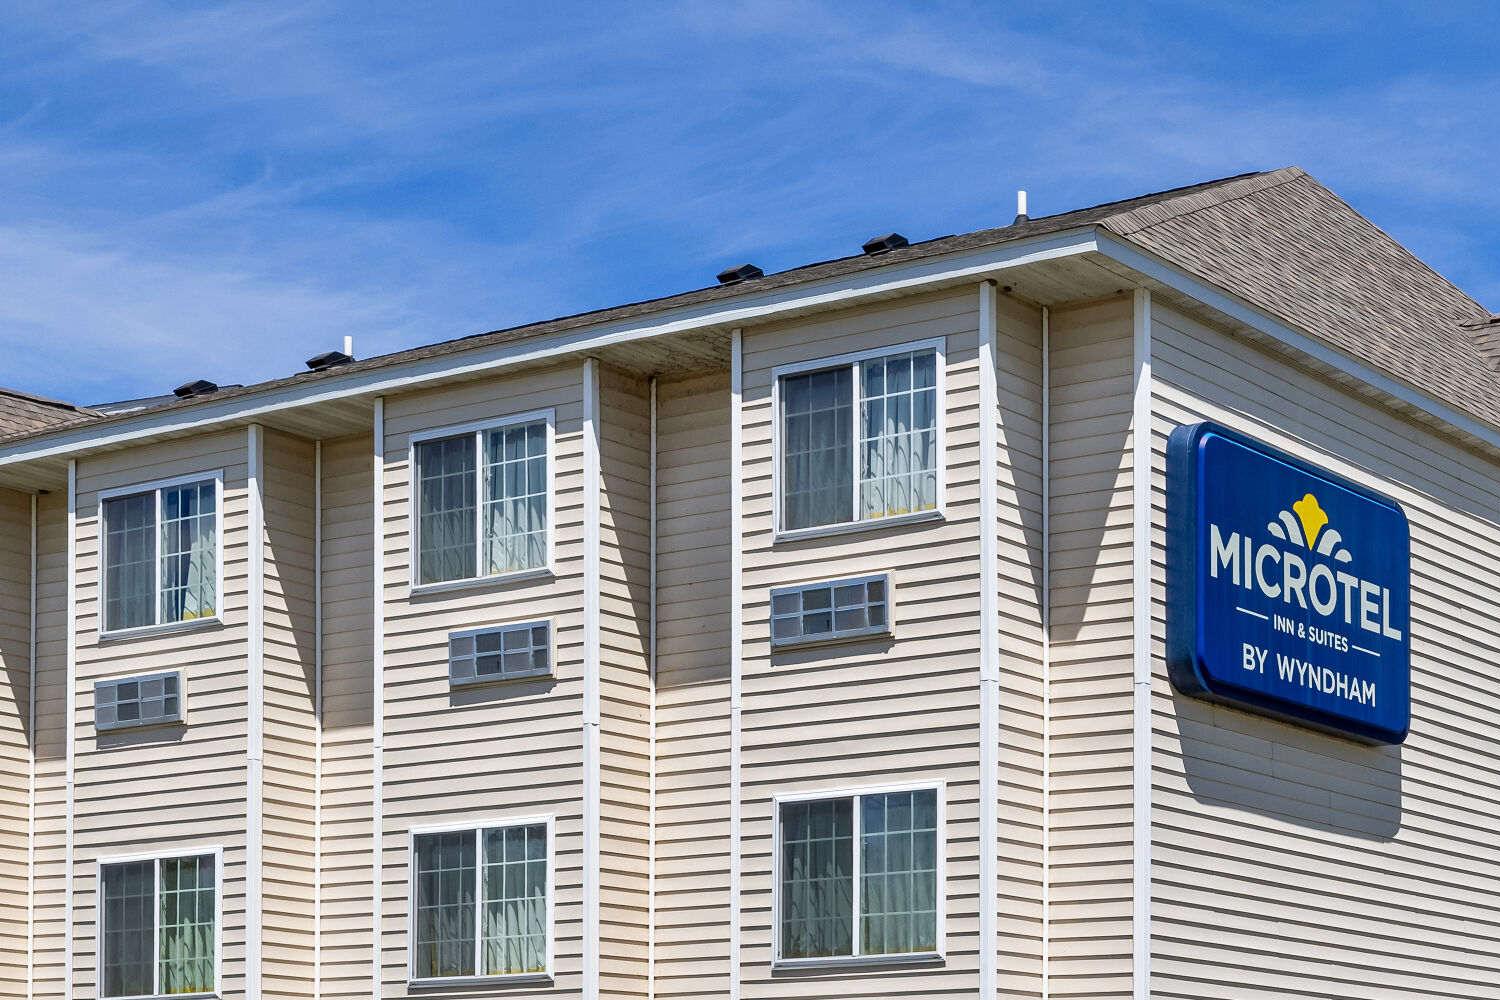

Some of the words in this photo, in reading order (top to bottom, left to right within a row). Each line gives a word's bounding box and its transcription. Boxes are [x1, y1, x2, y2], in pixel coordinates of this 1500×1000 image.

[1210, 523, 1402, 642] MICROTEL
[1273, 613, 1295, 636] INN
[1297, 622, 1306, 639] &
[1308, 626, 1349, 653] SUITES
[1242, 642, 1269, 674] BY
[1276, 653, 1376, 708] WYNDHAM
